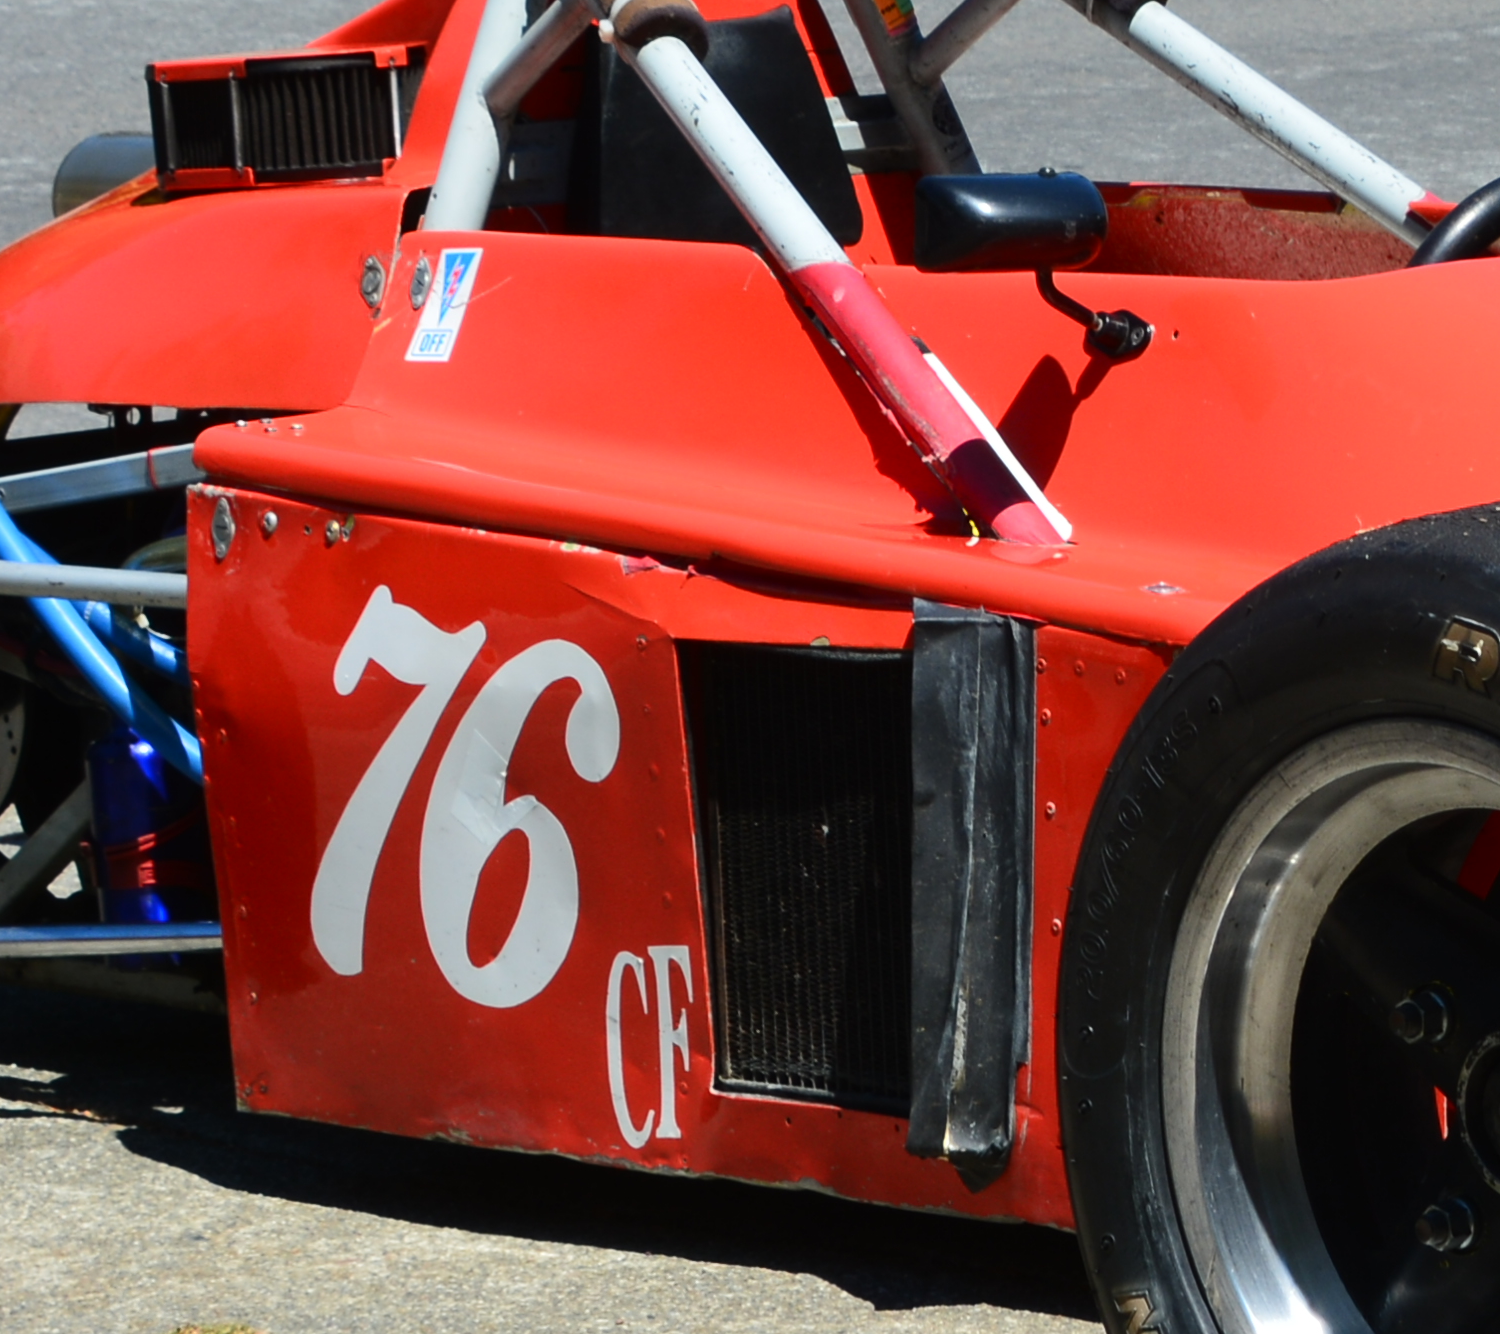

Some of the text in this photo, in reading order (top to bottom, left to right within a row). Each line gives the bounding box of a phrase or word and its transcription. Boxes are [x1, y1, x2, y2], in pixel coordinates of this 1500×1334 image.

[419, 333, 447, 353] OFF
[309, 582, 621, 1009] 76
[605, 943, 694, 1150] CF
